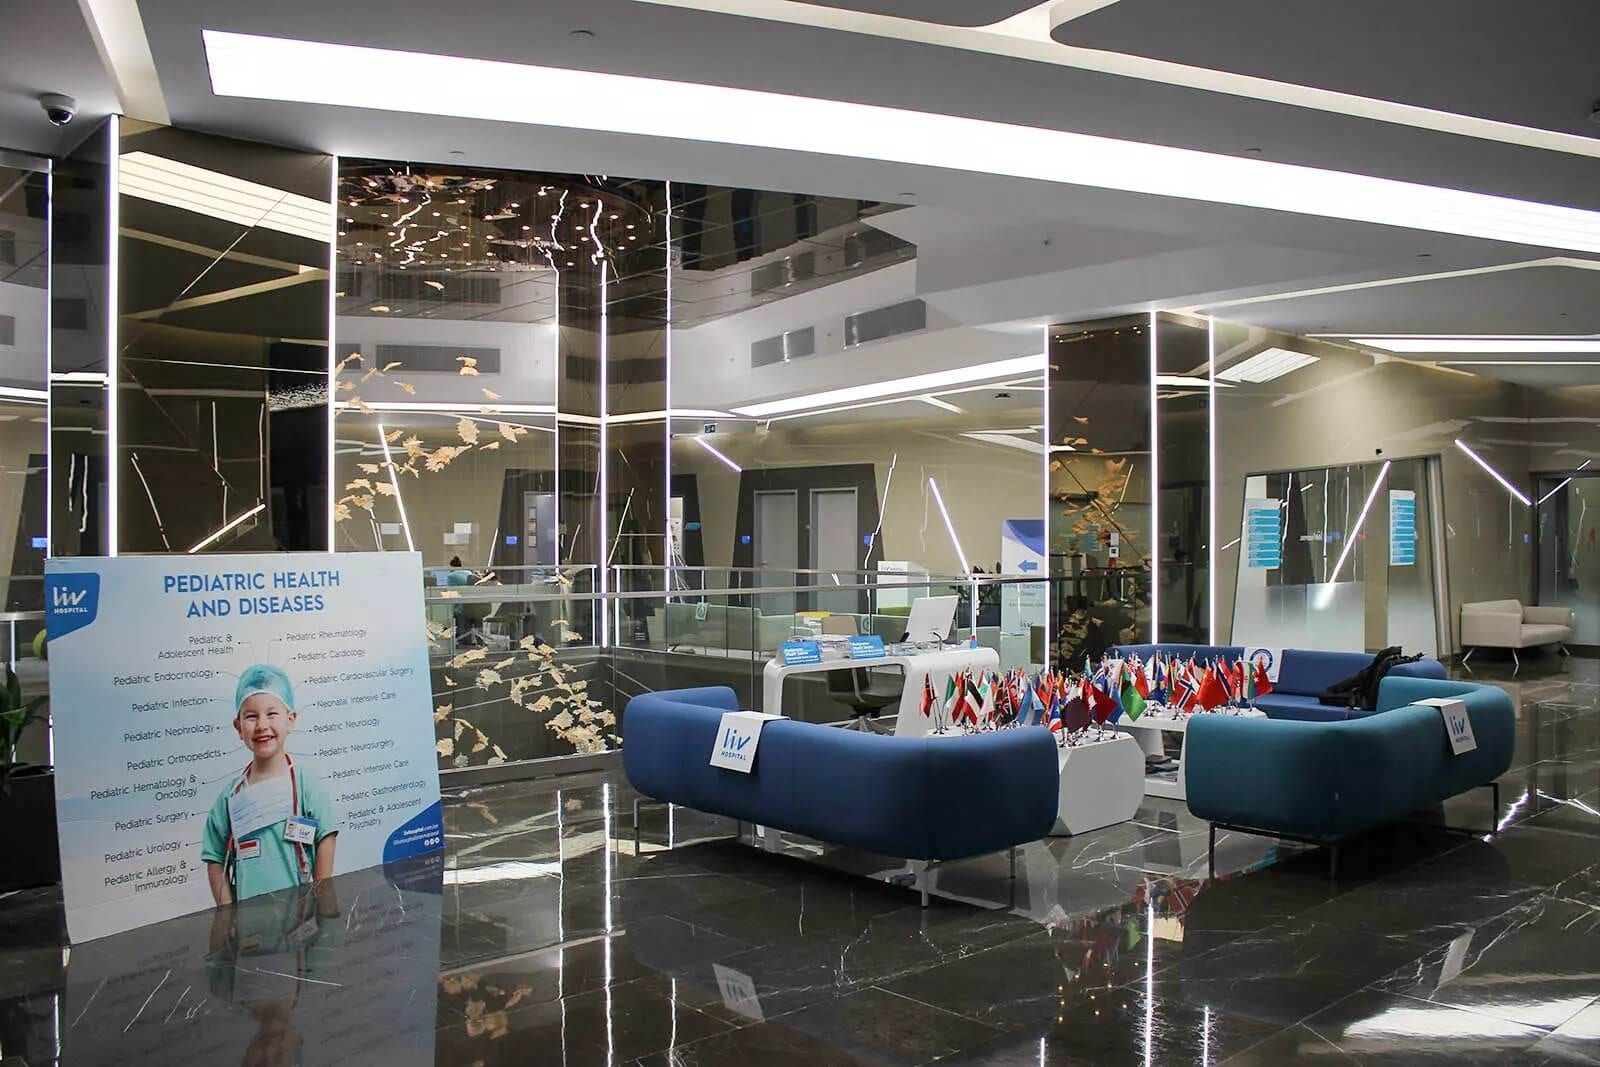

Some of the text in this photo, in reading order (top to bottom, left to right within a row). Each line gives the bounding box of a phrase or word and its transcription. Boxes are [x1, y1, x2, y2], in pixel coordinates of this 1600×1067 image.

[164, 571, 340, 593] PEDIATRIC HEALTH
[53, 586, 87, 606] liv
[187, 595, 324, 618] AND DISEASES
[189, 633, 232, 645] Pediatric &
[286, 632, 316, 641] Pediatric
[158, 645, 234, 660] Adolescent Health
[297, 648, 366, 661] Pediatric Cardiology
[113, 668, 214, 686] Pediatric Endocrinology
[308, 665, 414, 685] Pediatric Cardiovascular Surgery
[131, 696, 208, 713] Pediatric Infection
[317, 691, 397, 708] Neonatal Intensive Care
[124, 722, 214, 742] Pediatric Nephrology
[313, 717, 380, 734] Pediatric Neurology
[319, 739, 395, 757] Pediatric Neurosurgery
[723, 728, 751, 750] liv
[127, 749, 222, 771] Pediatric Orthopedicts
[720, 751, 747, 761] HOSPITAL
[332, 759, 409, 779] Pediatric Intensive Care
[90, 774, 197, 800] Pediatric Hematology &
[155, 786, 198, 801] Oncology
[341, 778, 426, 802] Pediatric Gastroenterology
[348, 798, 422, 820] Pediatric & Adolescent
[115, 810, 189, 832] Pediatric Surgery
[349, 817, 382, 831] Psychiatry
[104, 840, 182, 863] Pediatric Urology
[104, 860, 187, 887] Pediatric Allergy &
[134, 873, 189, 892] Immunology
